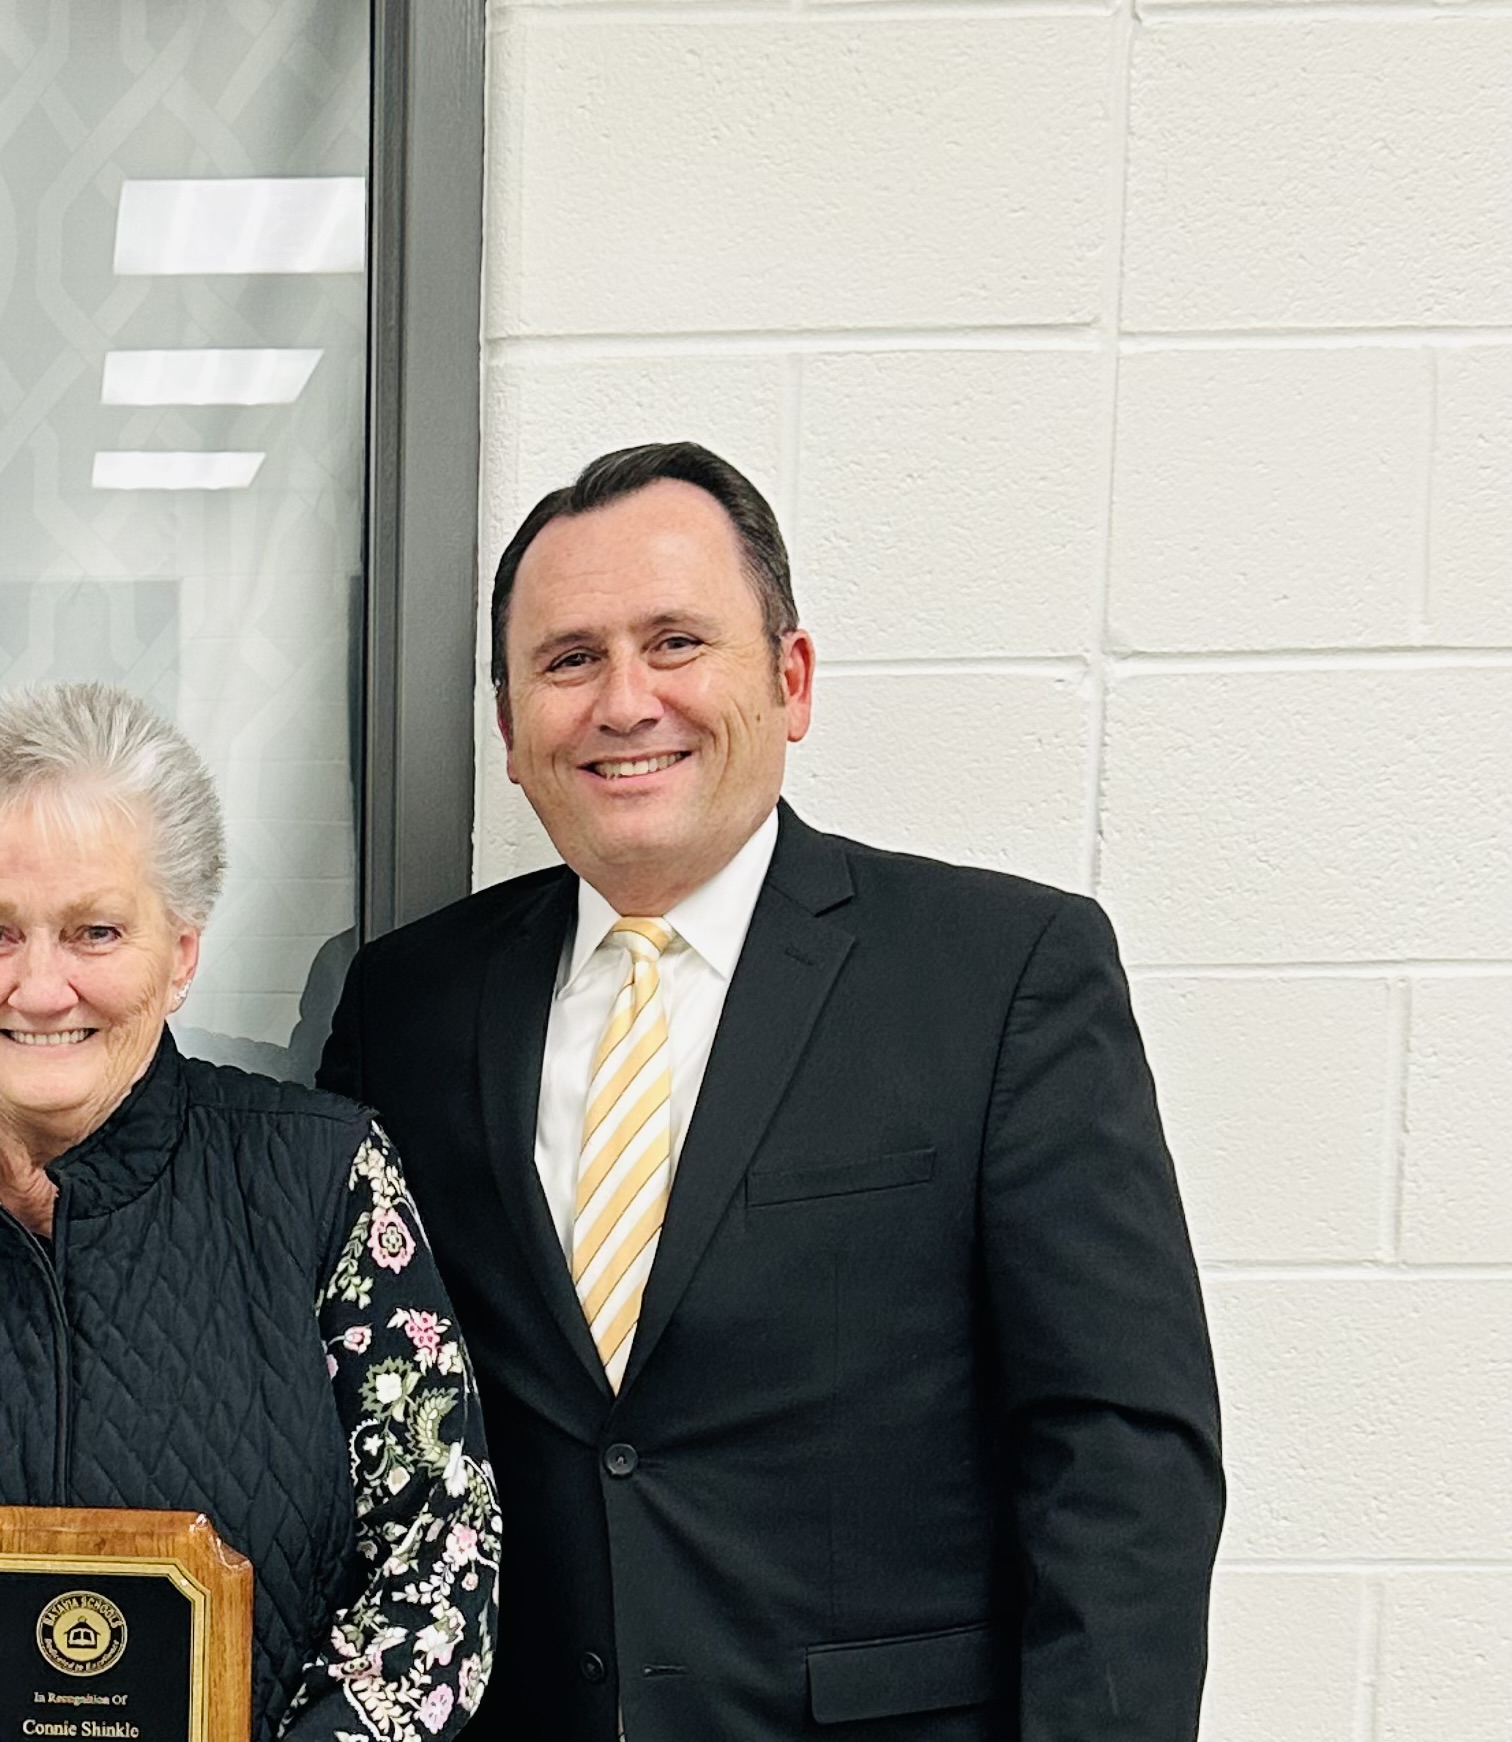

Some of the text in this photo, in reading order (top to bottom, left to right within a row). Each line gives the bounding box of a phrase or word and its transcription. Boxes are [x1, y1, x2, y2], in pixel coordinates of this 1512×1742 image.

[34, 1692, 128, 1706] In Recognition Of
[22, 1719, 140, 1738] Connie Shinkle
